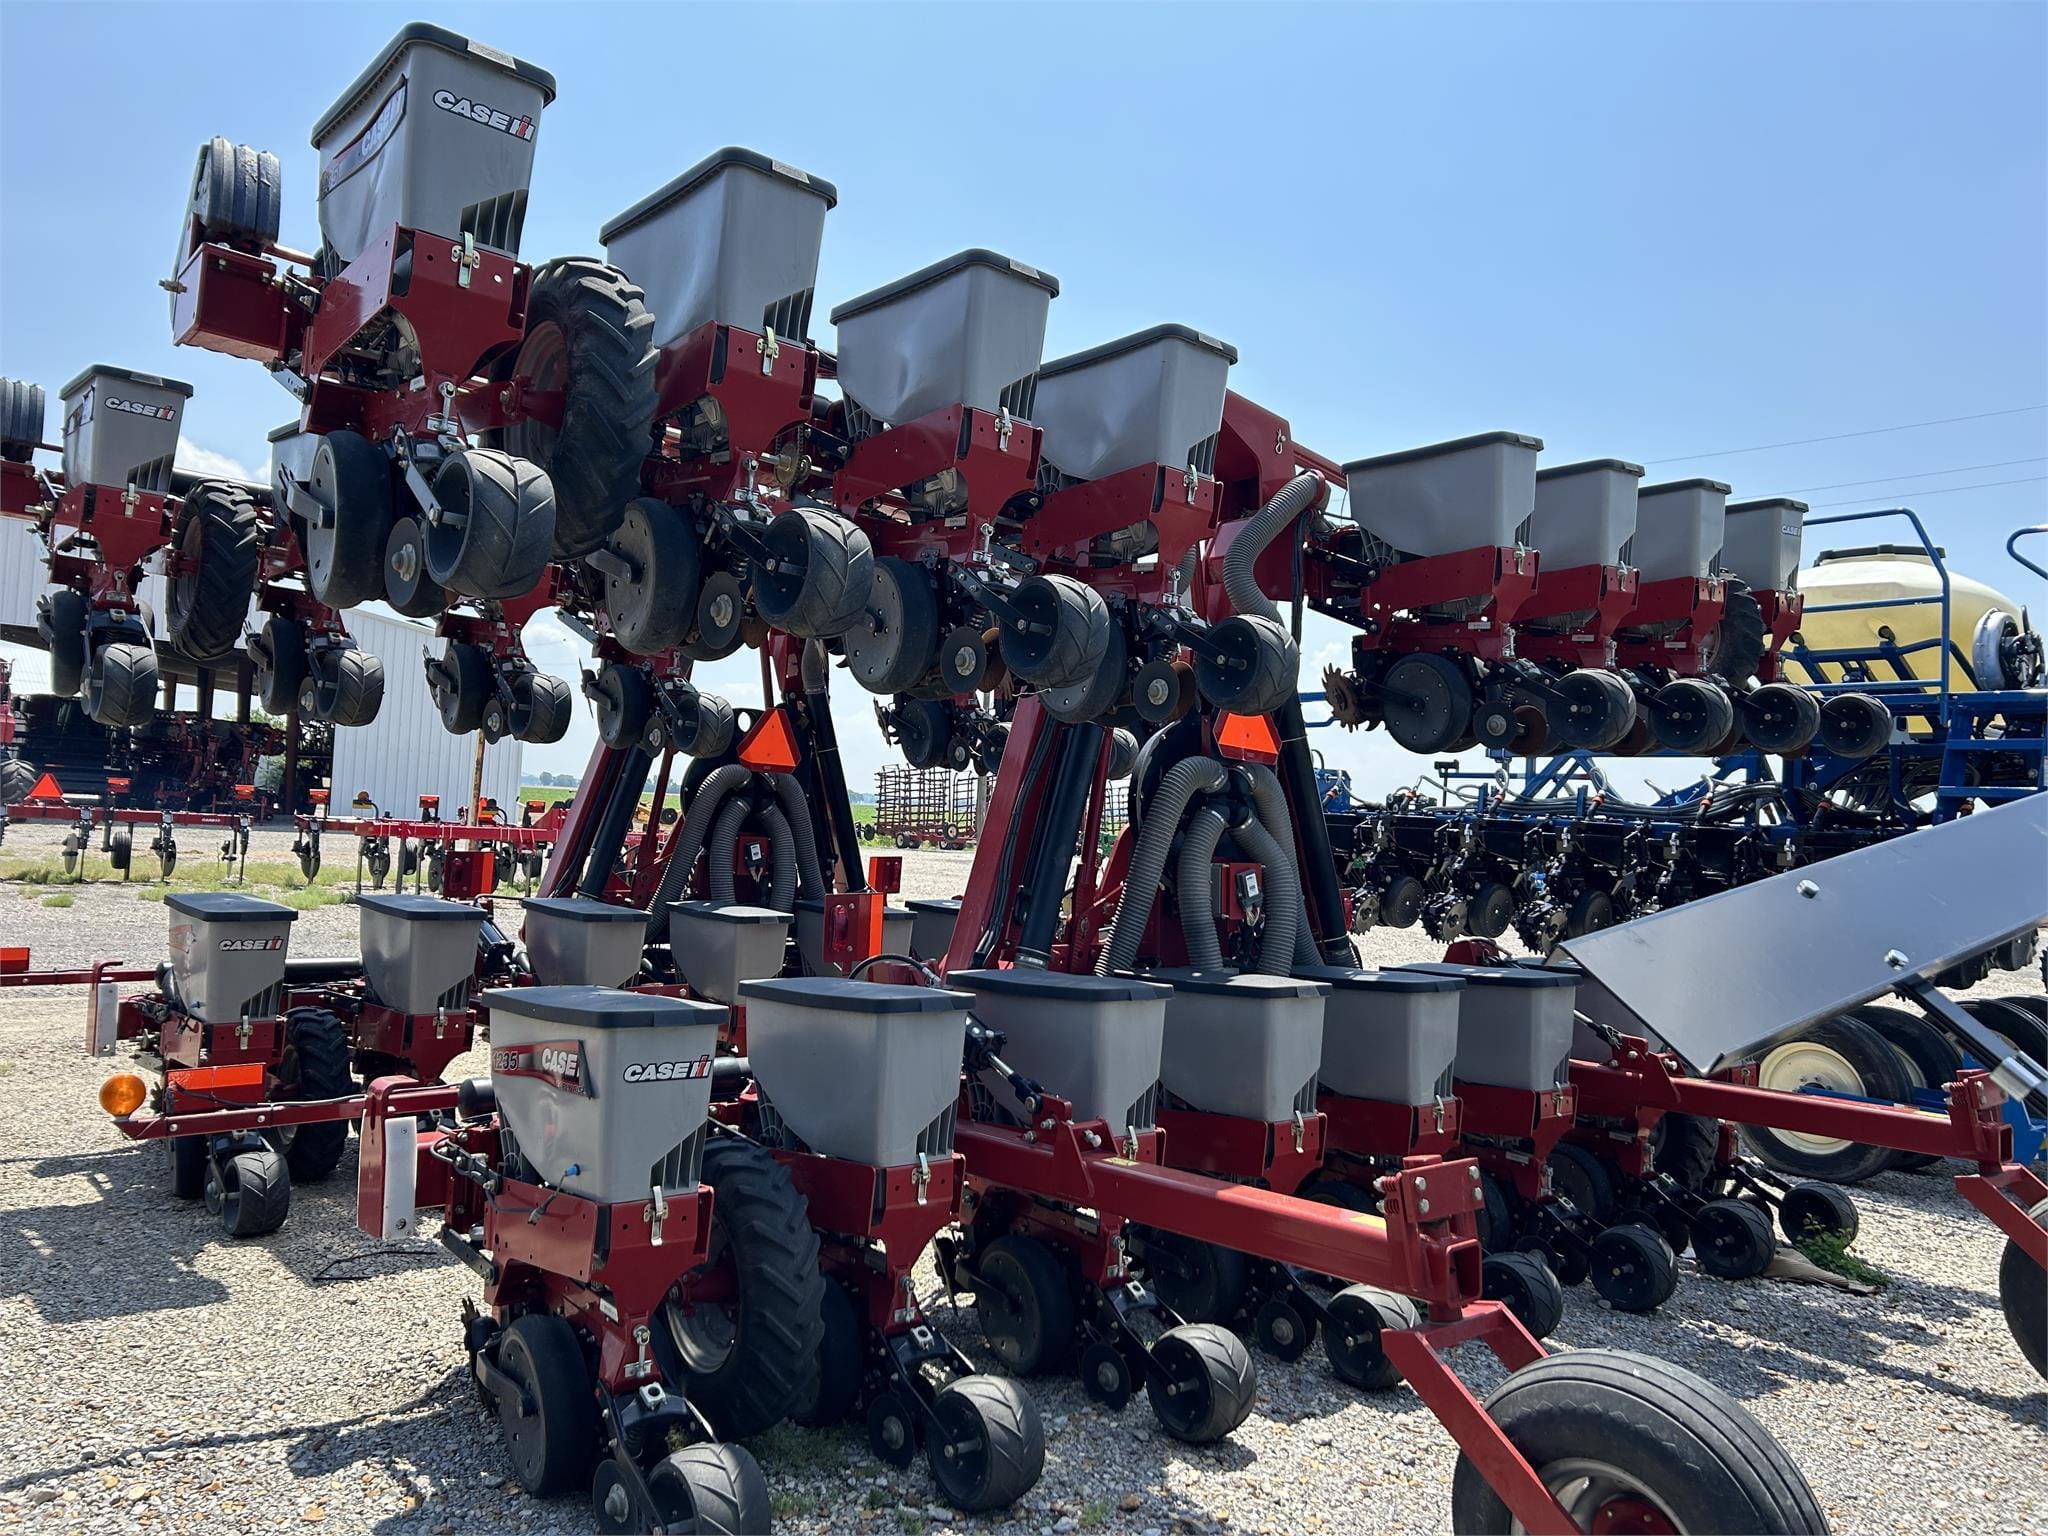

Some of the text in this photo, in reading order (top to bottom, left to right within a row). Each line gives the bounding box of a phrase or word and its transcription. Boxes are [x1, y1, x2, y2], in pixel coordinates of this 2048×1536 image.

[433, 91, 511, 128] CASE
[105, 398, 157, 416] CASE
[219, 940, 267, 950] CASE
[542, 1048, 578, 1076] CASE
[624, 1063, 689, 1082] CASE
